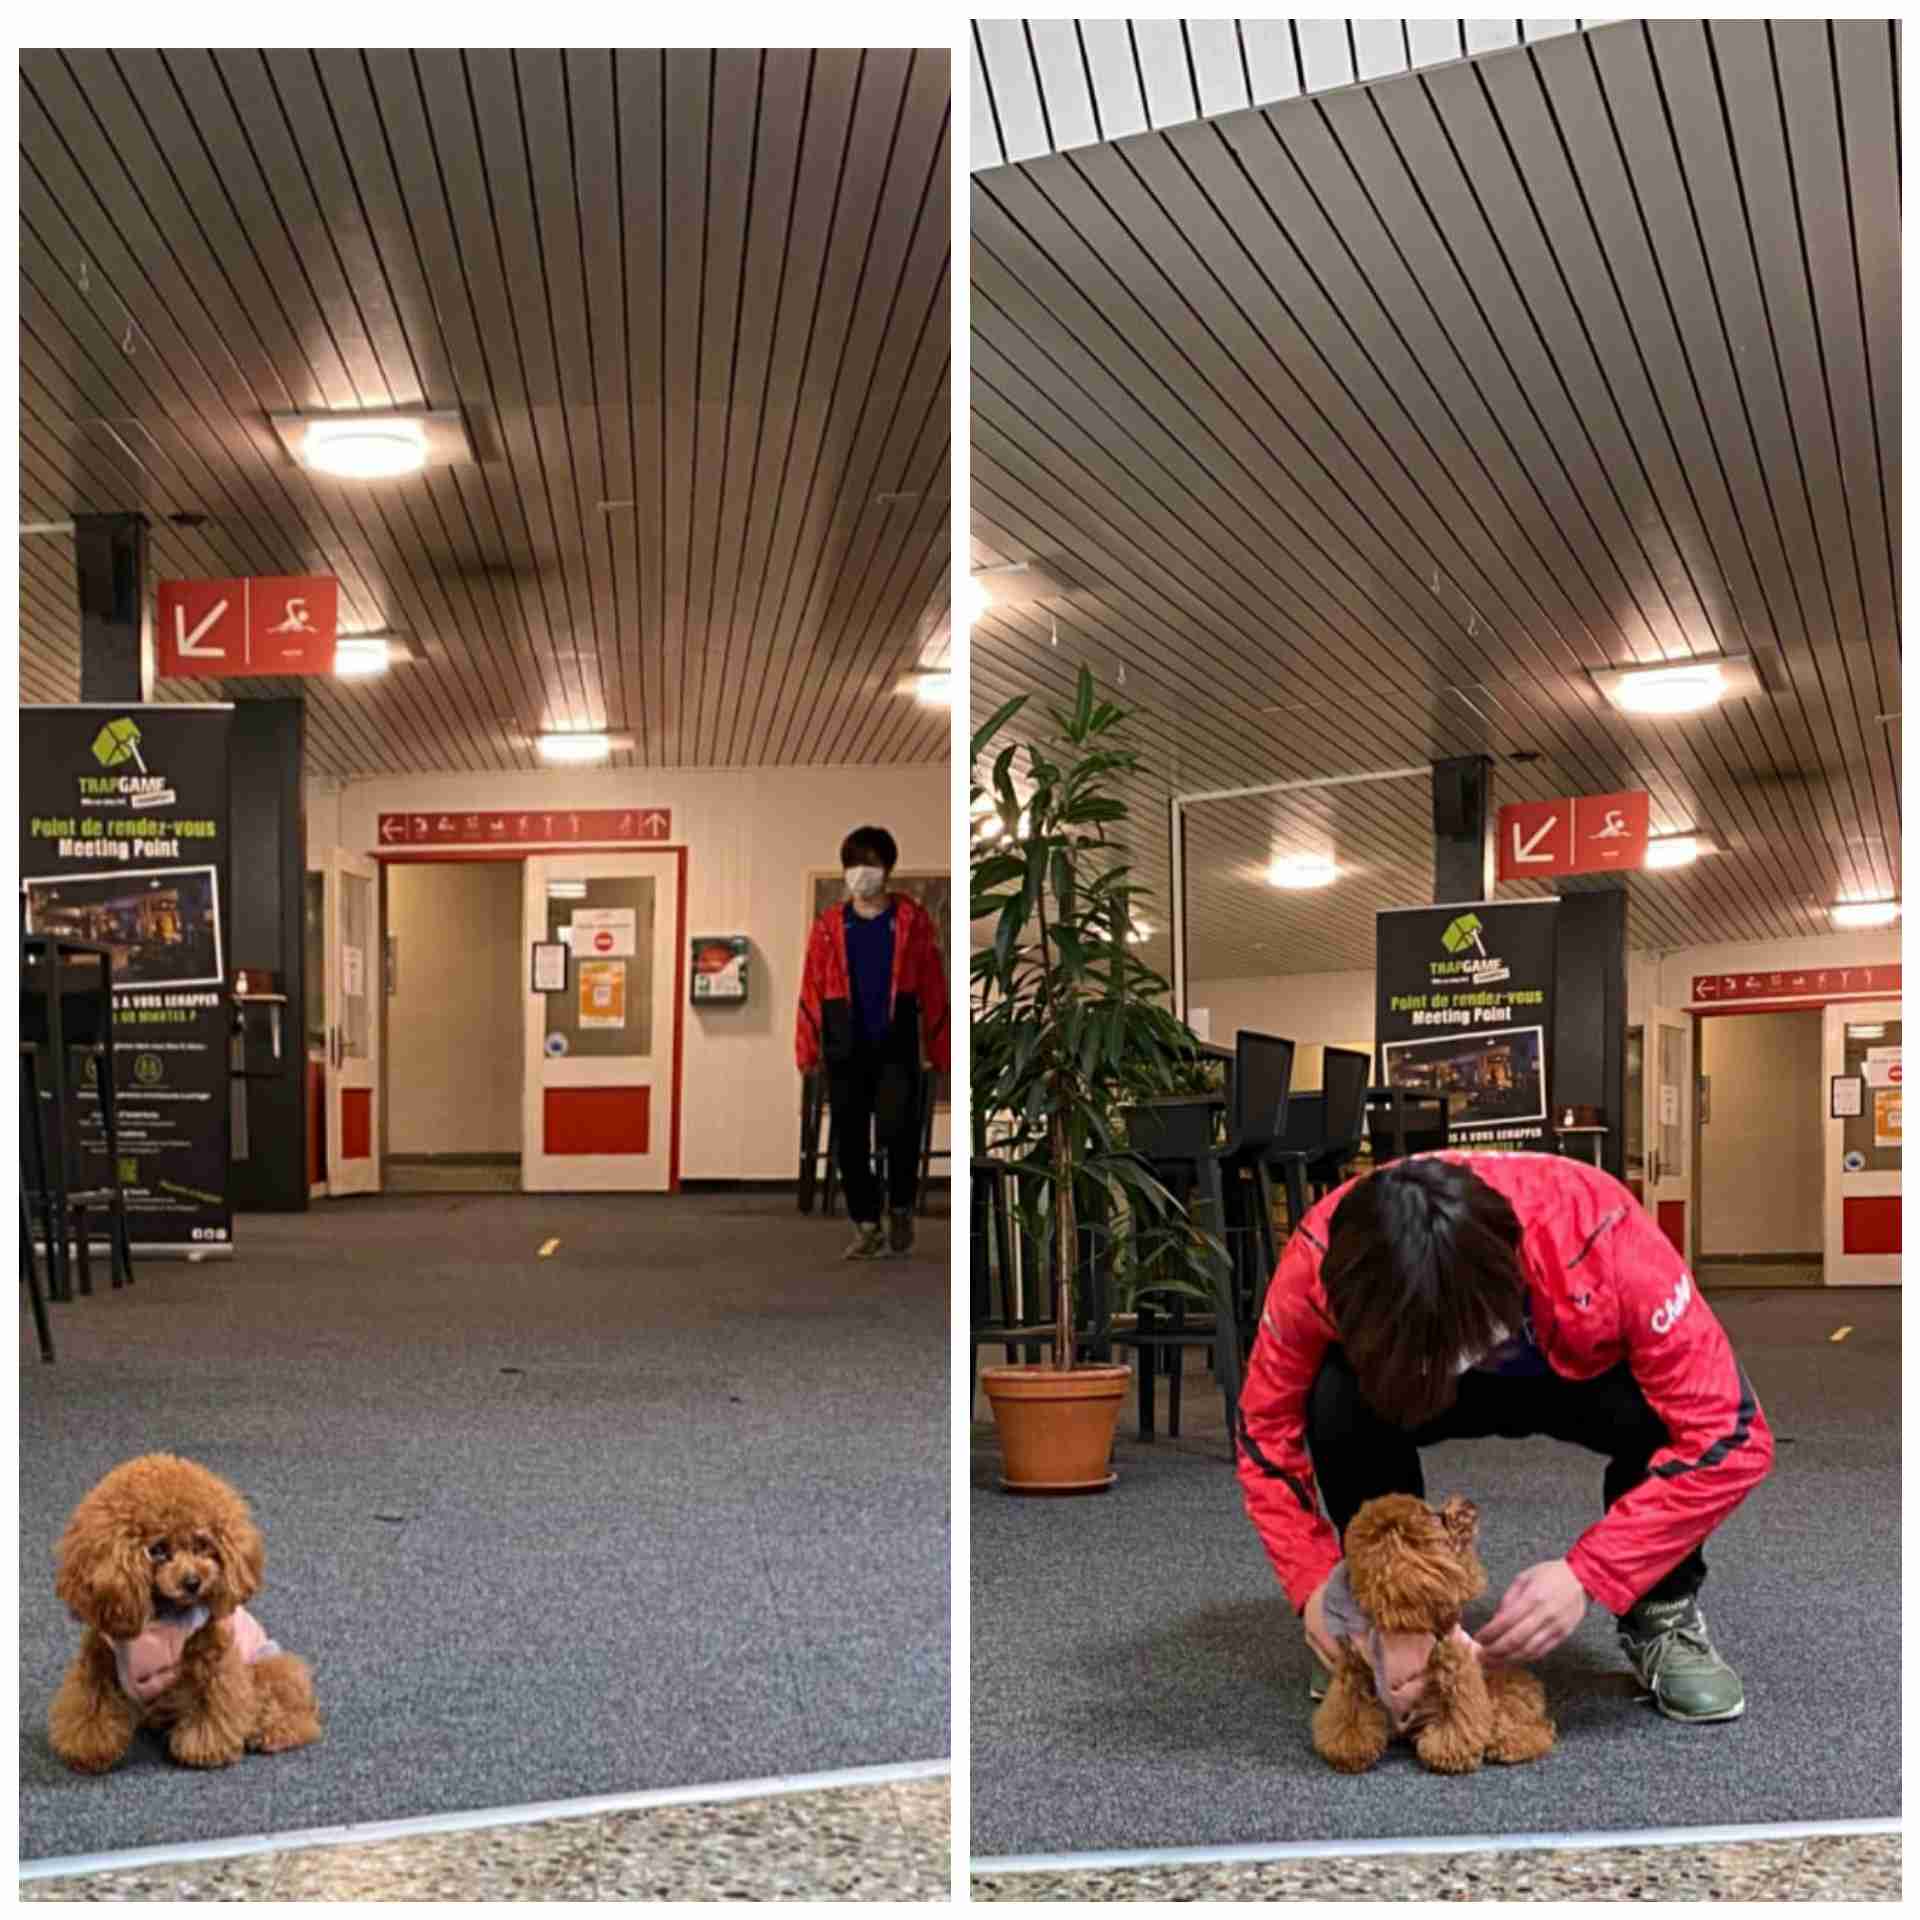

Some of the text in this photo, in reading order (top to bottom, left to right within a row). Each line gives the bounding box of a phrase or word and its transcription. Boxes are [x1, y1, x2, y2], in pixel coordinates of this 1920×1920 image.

[79, 777, 166, 793] TRAPGAME
[31, 818, 217, 838] Point de rendez-vous
[59, 839, 180, 860] Meeting Point
[1391, 990, 1545, 1010] Point de rendez-vous
[1412, 1006, 1512, 1025] Meeting Point
